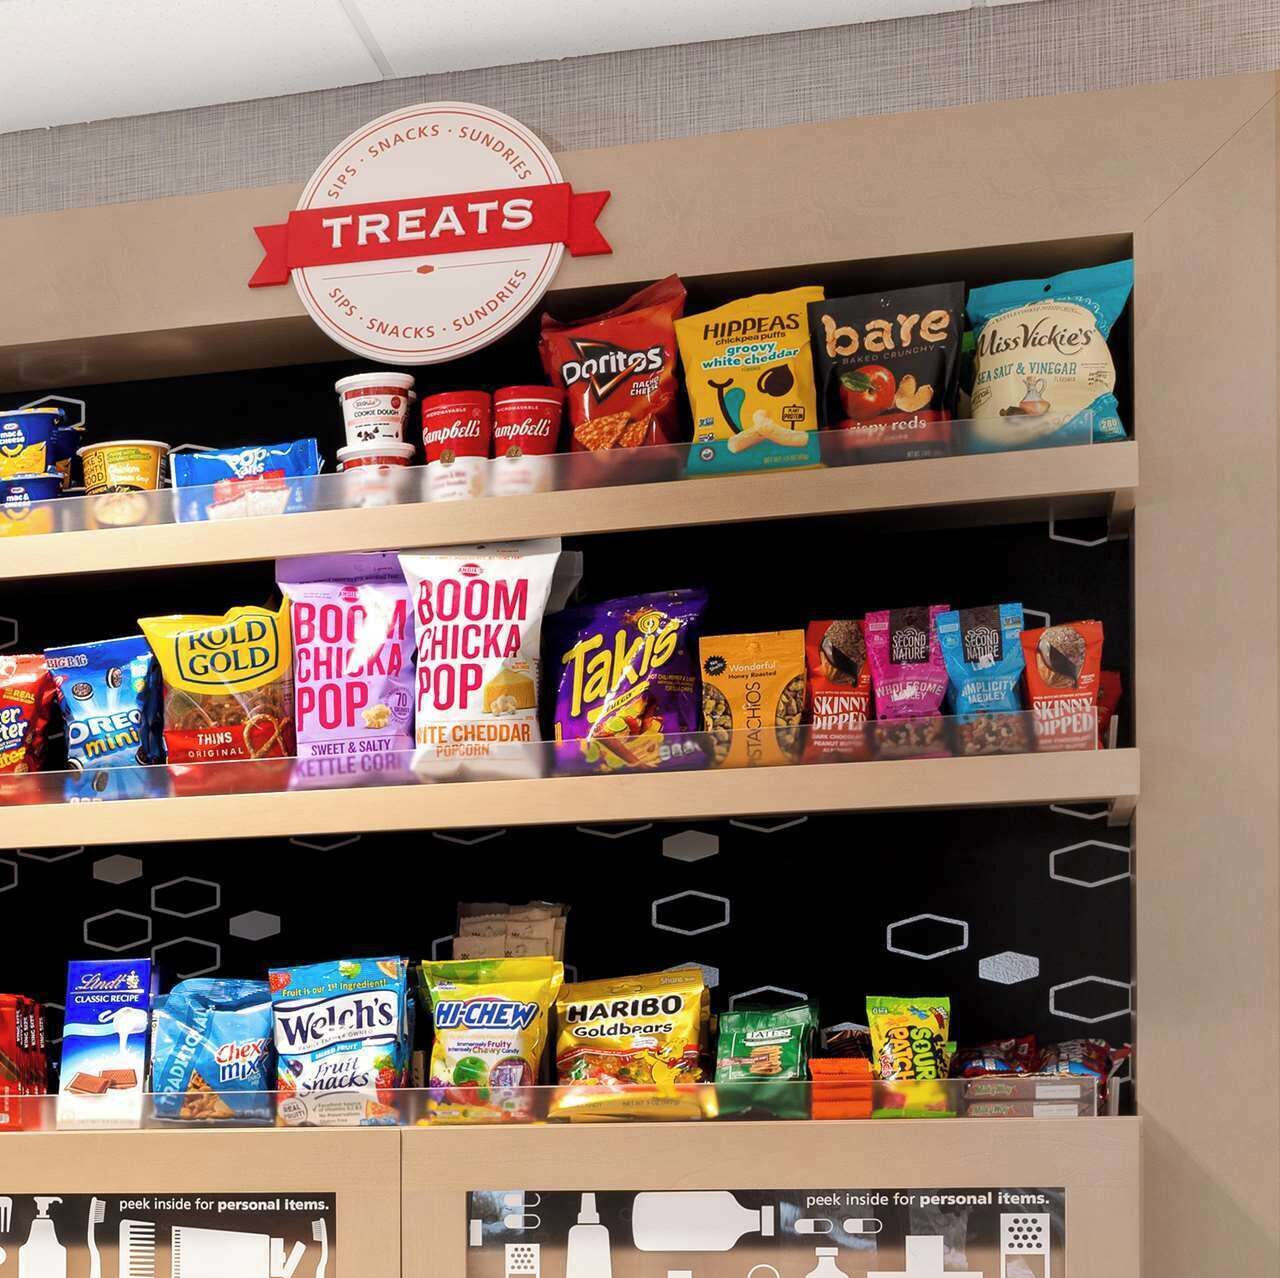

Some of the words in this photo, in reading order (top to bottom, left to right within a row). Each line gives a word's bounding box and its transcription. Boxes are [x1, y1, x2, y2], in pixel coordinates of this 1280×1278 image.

[327, 163, 358, 199] SIPS
[367, 123, 441, 159] SNACKS
[458, 126, 533, 181] SUNDRIES
[321, 198, 535, 249] TREATS
[328, 286, 358, 317] SIPS
[365, 318, 437, 341] SNACKS
[451, 268, 528, 333] SUNDRIES
[703, 313, 800, 341] HIPPEAS
[715, 333, 759, 346] chickpea
[759, 331, 786, 342] puffs
[822, 310, 951, 357] bare
[1020, 315, 1092, 356] Vickie's
[702, 355, 741, 369] white
[742, 347, 799, 365] cheddar
[726, 341, 776, 357] groovy
[842, 354, 879, 365] BAKED
[883, 344, 936, 361] CRUNCHY
[561, 347, 663, 386] Doritos
[992, 362, 1015, 381] SALT
[1016, 362, 1026, 374] &
[1029, 362, 1078, 376] VINEGAR
[416, 578, 528, 627] BOOM
[188, 620, 267, 651] ROLD
[416, 624, 522, 663] CHICKA
[892, 628, 927, 648] SECOND
[188, 646, 270, 676] GOLD
[561, 611, 682, 718] Takis
[892, 646, 926, 661] NATURE
[728, 662, 776, 673] Wonderful
[416, 663, 483, 713] POP
[297, 681, 369, 732] POP
[813, 696, 870, 716] SKINNY
[1033, 697, 1094, 720] SKINNY
[813, 712, 867, 731] DIPPED
[1034, 713, 1094, 736] DIPPED
[84, 730, 140, 759] mini
[197, 731, 233, 746] THINS
[311, 742, 345, 756] SWEET
[348, 743, 357, 753] &
[360, 738, 391, 752] SALTY
[188, 747, 244, 759] ORIGINAL
[75, 973, 123, 991] Lindt
[282, 988, 302, 997] Fruit
[311, 985, 325, 994] our
[74, 995, 110, 1004] CLASSIC
[110, 993, 140, 1003] RECIPE
[567, 995, 683, 1023] HARIBO
[278, 997, 394, 1046] Welch's
[435, 1001, 539, 1030] HI-CHEW
[574, 1022, 674, 1038] Goldbears
[215, 1039, 264, 1064] Chex
[487, 1039, 513, 1050] Fruity
[911, 1026, 938, 1081] SOUR
[220, 1060, 259, 1082] mix
[315, 1057, 359, 1079] Fruit
[299, 1071, 370, 1098] Snacks
[119, 1198, 150, 1212] peek
[154, 1197, 192, 1211] inside
[195, 1197, 215, 1211] for
[217, 1198, 281, 1213] personal
[284, 1198, 330, 1212] items.
[806, 1193, 842, 1209] peek
[845, 1192, 890, 1207] inside
[894, 1192, 916, 1207] for
[920, 1191, 994, 1209] personal
[997, 1191, 1050, 1206] items.
